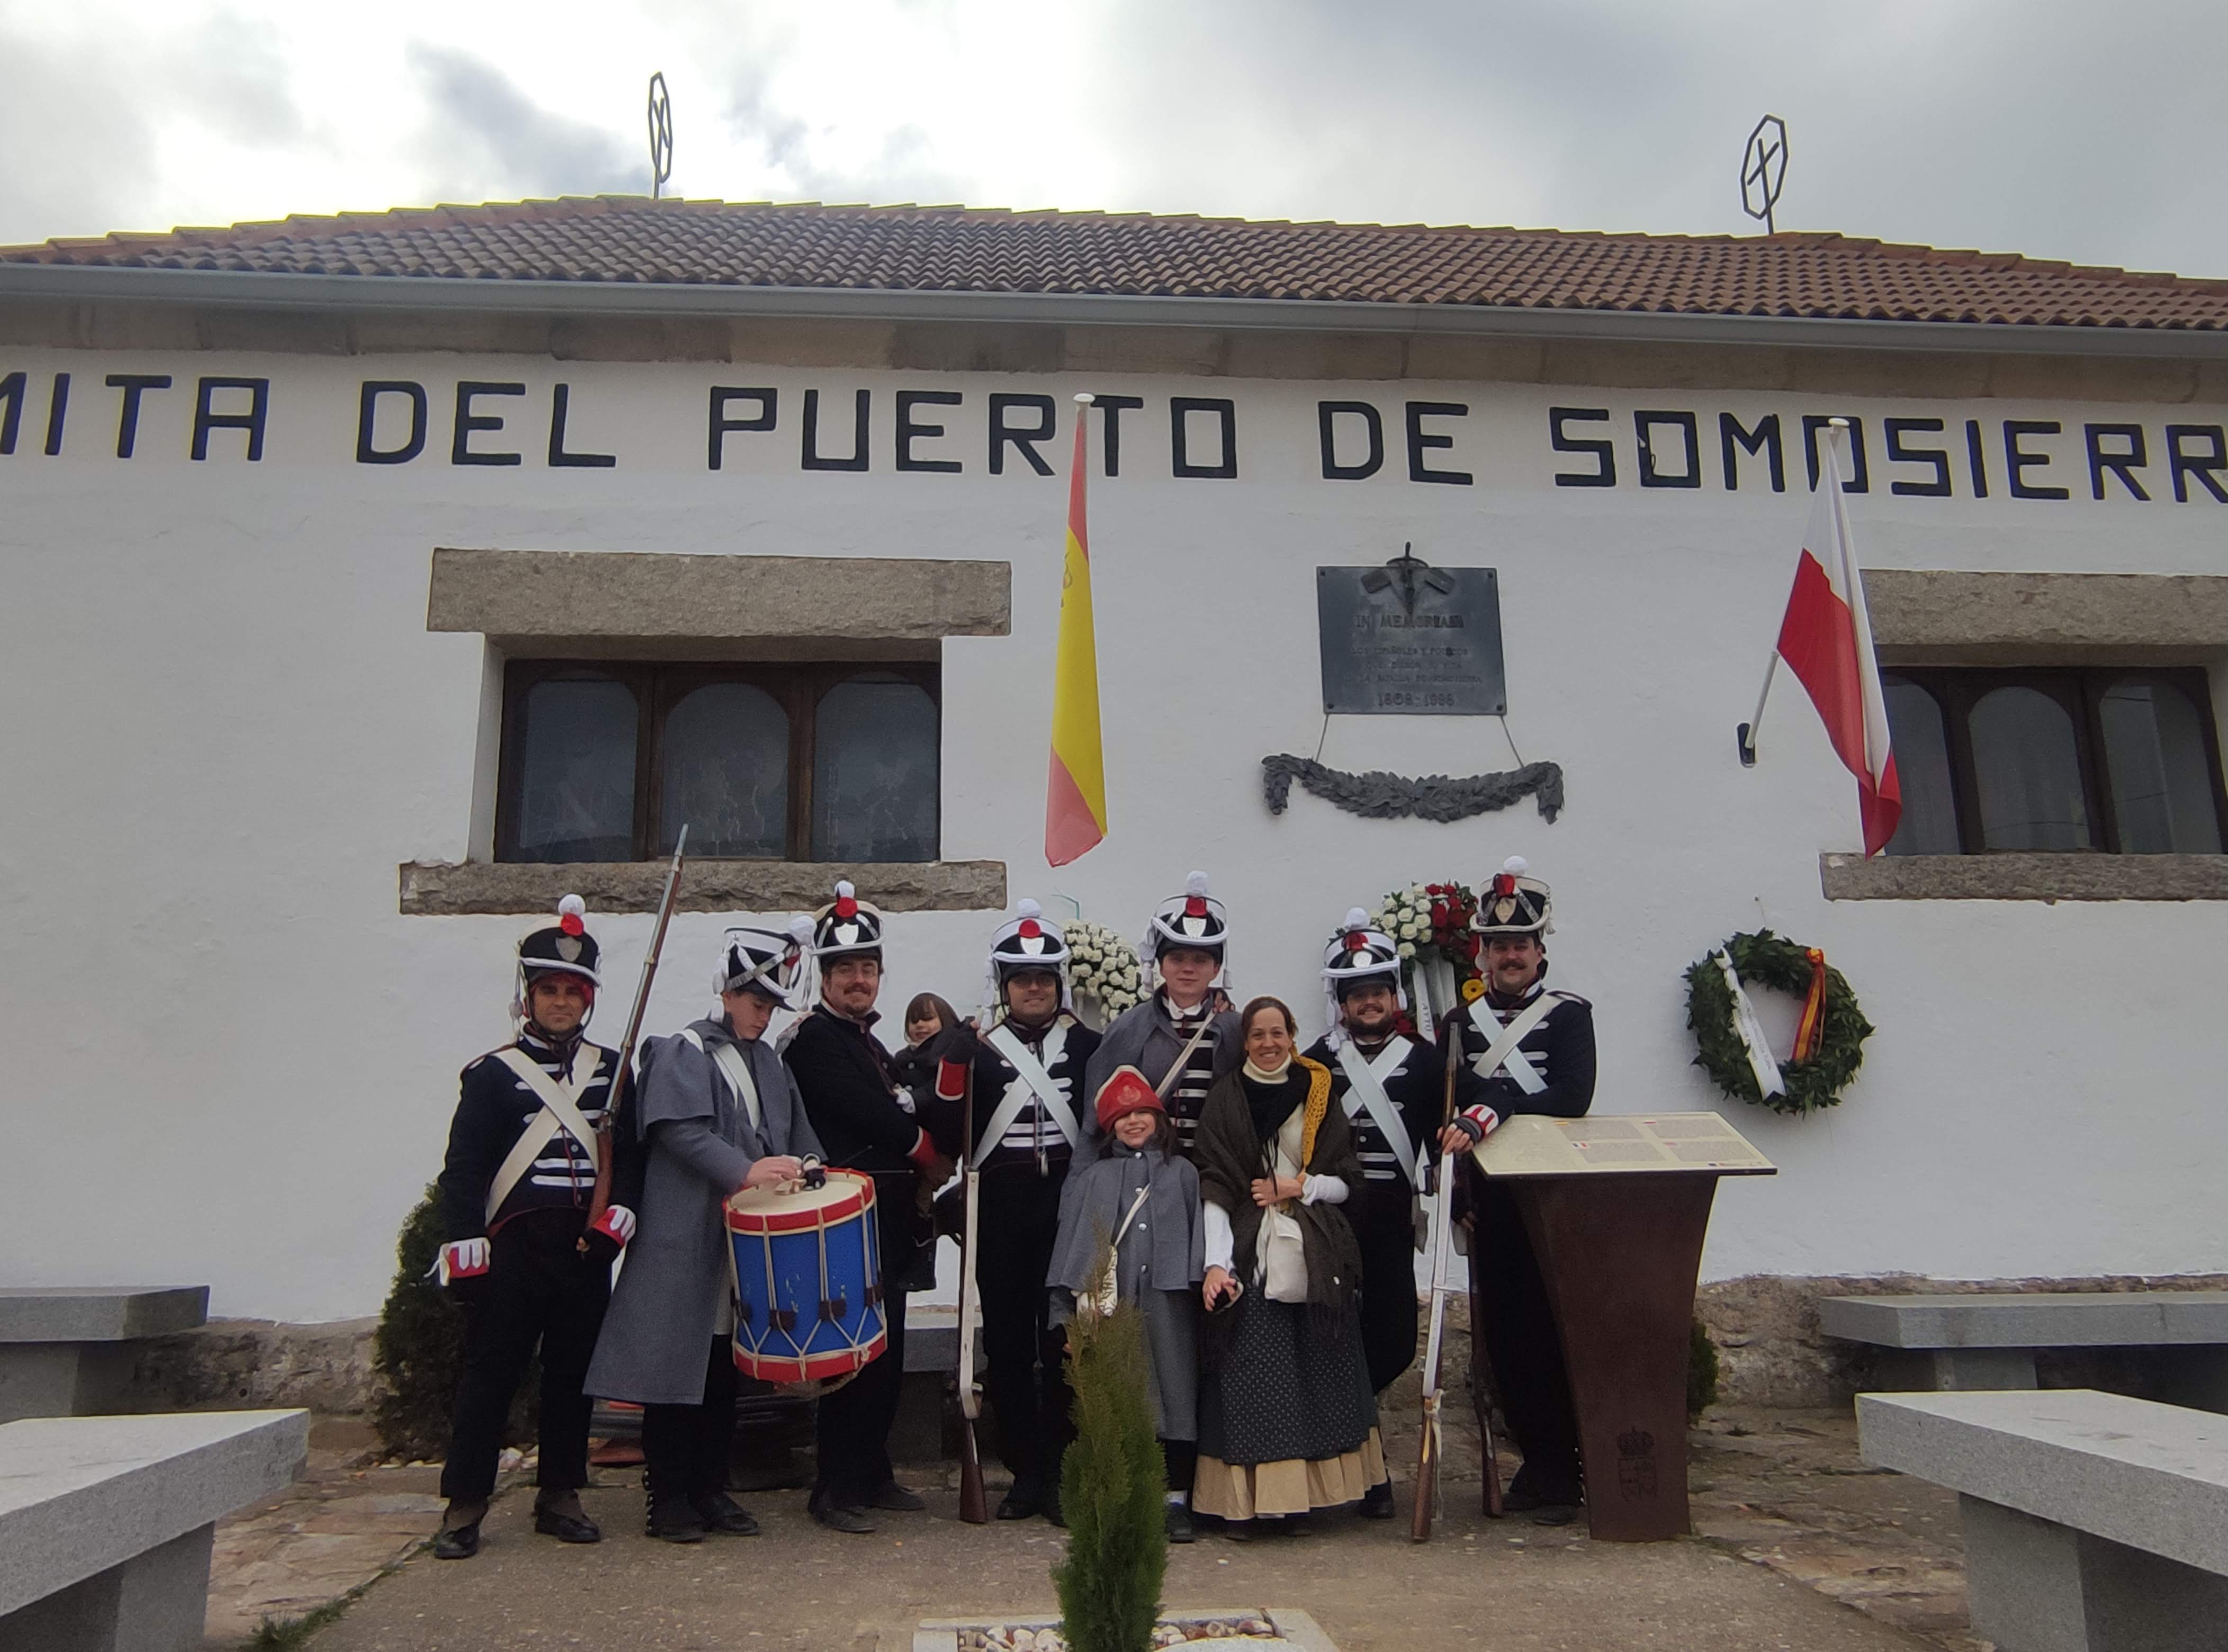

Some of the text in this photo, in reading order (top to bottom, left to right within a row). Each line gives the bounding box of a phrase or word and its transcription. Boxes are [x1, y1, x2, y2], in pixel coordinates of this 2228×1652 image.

[357, 381, 615, 467] DEL
[709, 386, 1237, 479] PUERTO
[1318, 401, 1472, 485] DE
